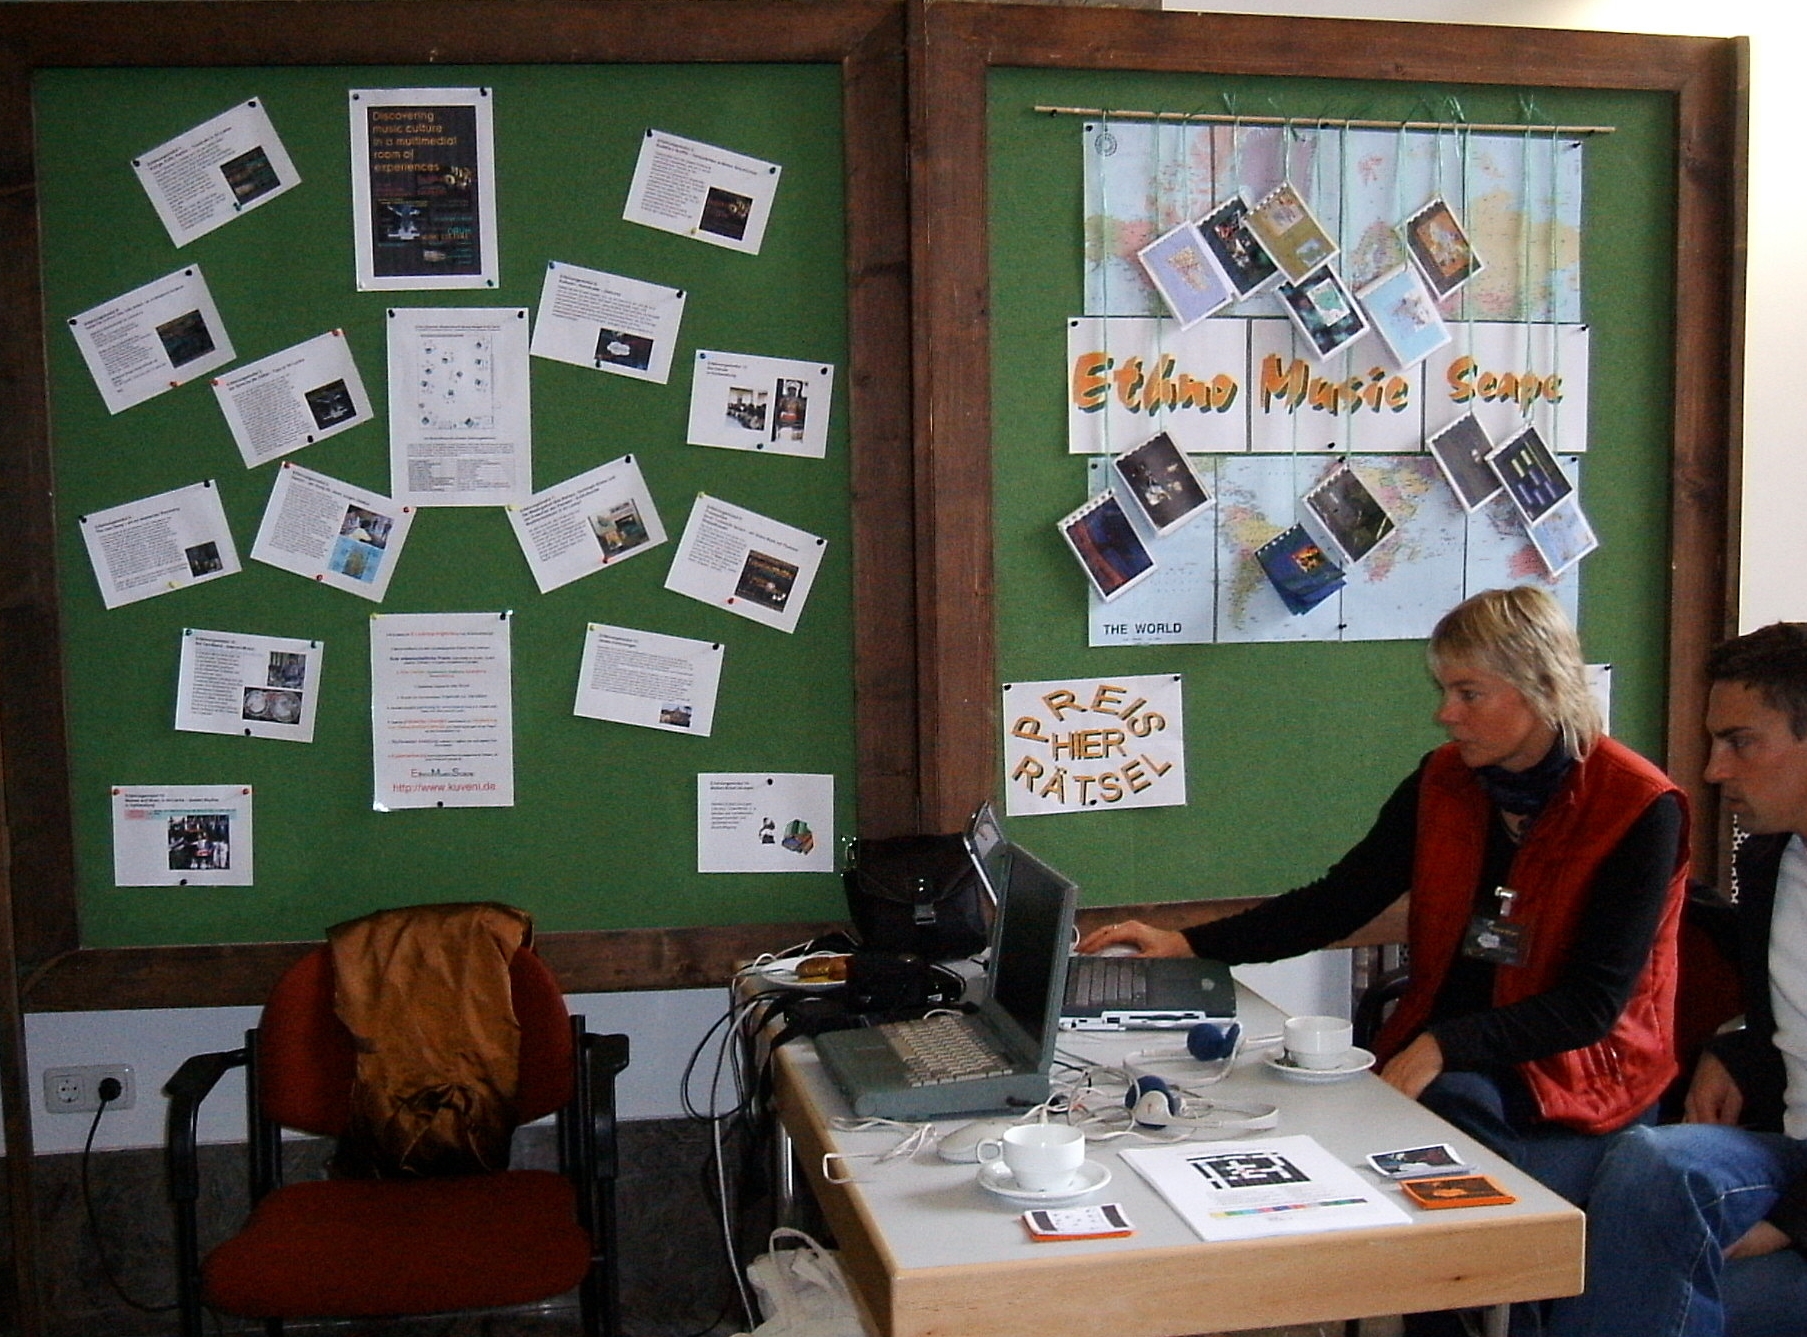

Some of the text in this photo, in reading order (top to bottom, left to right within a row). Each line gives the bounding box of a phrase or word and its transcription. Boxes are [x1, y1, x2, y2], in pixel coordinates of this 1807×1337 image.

[372, 111, 434, 122] Discovering
[373, 124, 443, 133] music culture
[373, 138, 383, 146] in
[374, 151, 400, 159] room
[374, 163, 440, 173] experiences
[1072, 351, 1563, 418] Ethno Music Scape
[1103, 622, 1182, 635] THE WORLD
[1011, 684, 1166, 743] PREIS
[1051, 727, 1127, 761] HIER
[1011, 754, 1173, 806] RÄTSEL
